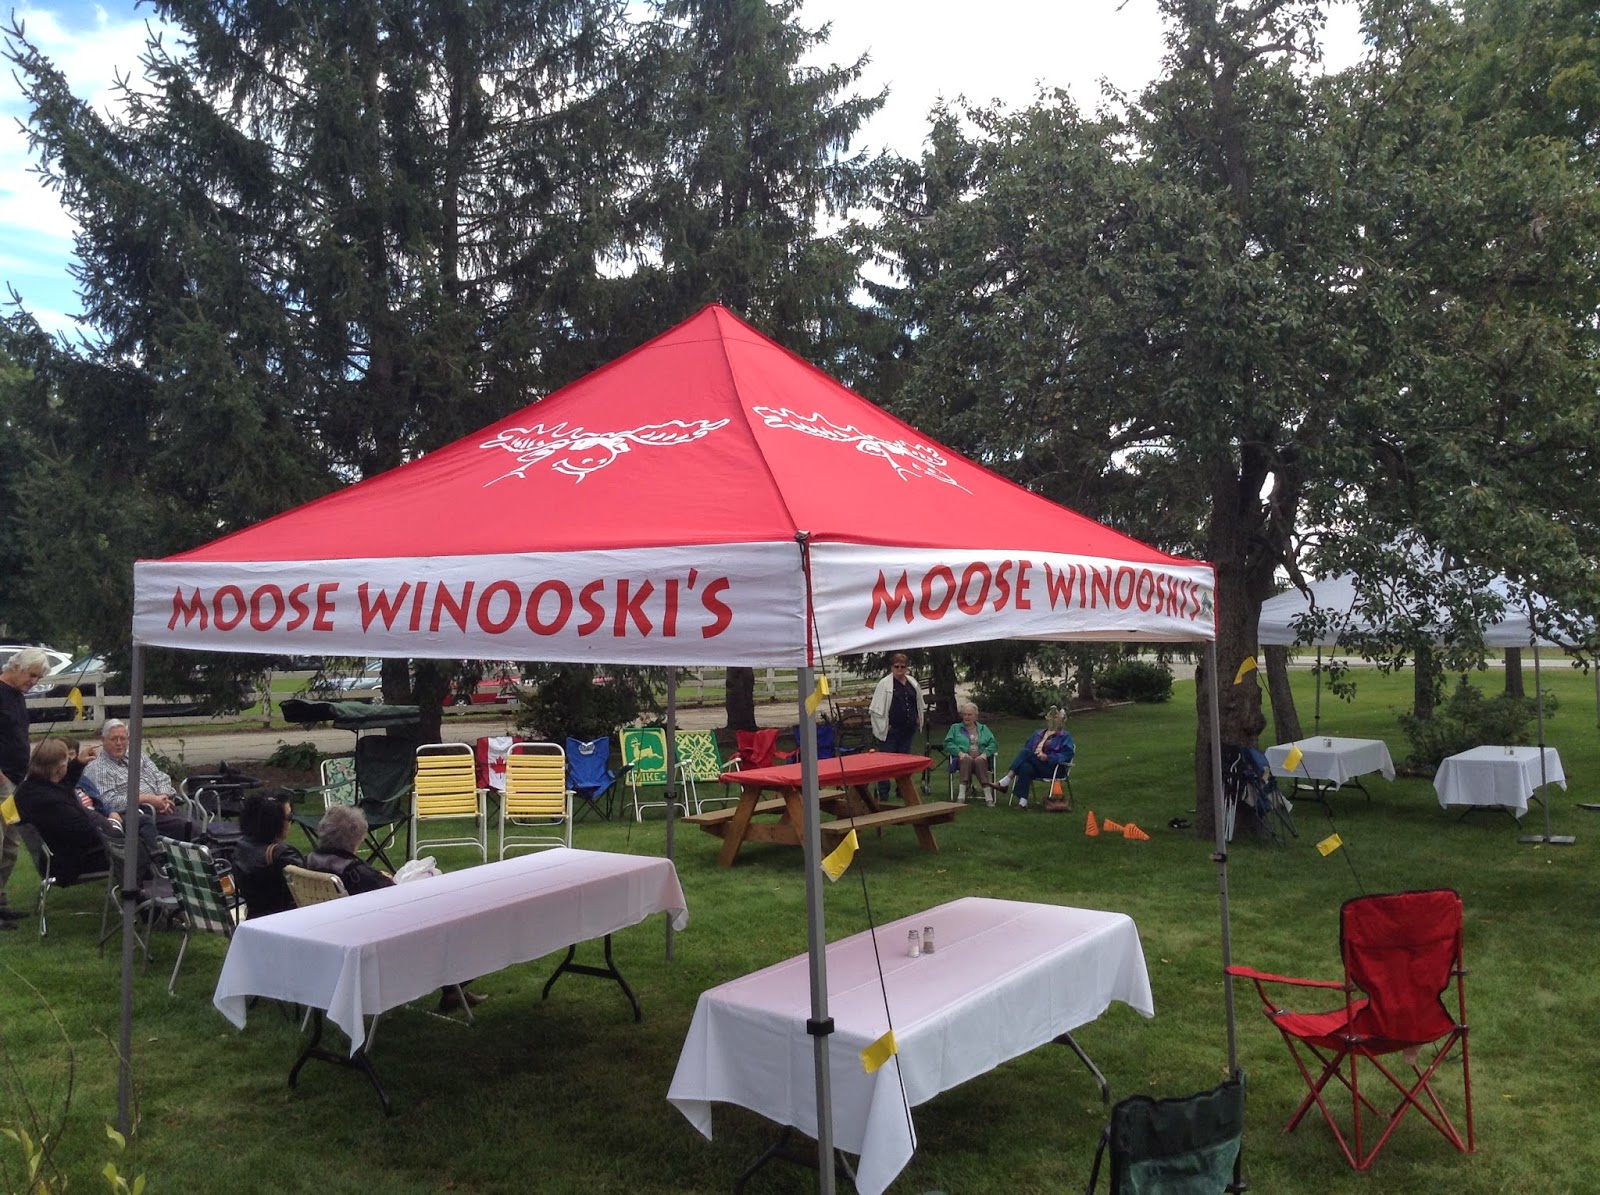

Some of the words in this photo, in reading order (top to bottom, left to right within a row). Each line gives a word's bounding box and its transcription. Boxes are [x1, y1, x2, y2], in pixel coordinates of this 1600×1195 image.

[168, 582, 339, 632] MOOSE
[357, 567, 733, 639] WINOOSKI'S
[865, 560, 1032, 630] MOOSE
[1043, 561, 1200, 621] WINOOSKI'S
